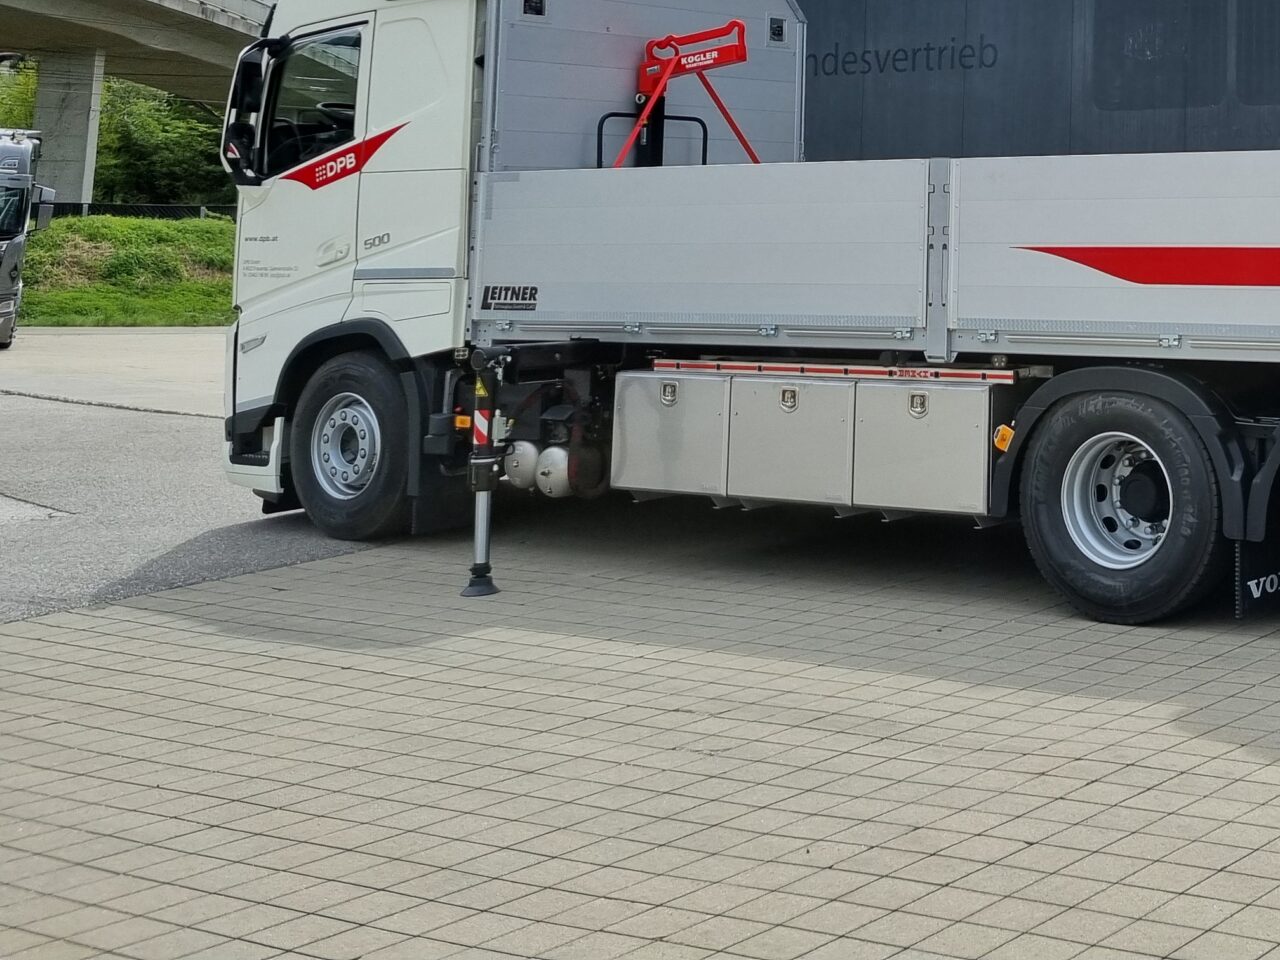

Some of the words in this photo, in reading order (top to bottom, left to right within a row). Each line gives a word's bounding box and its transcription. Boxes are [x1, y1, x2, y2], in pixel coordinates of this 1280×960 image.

[681, 50, 719, 66] KOGLER
[802, 33, 998, 77] ndesvertrieb
[326, 152, 357, 179] DPB
[363, 232, 391, 251] 500
[480, 285, 539, 311] LEITNER
